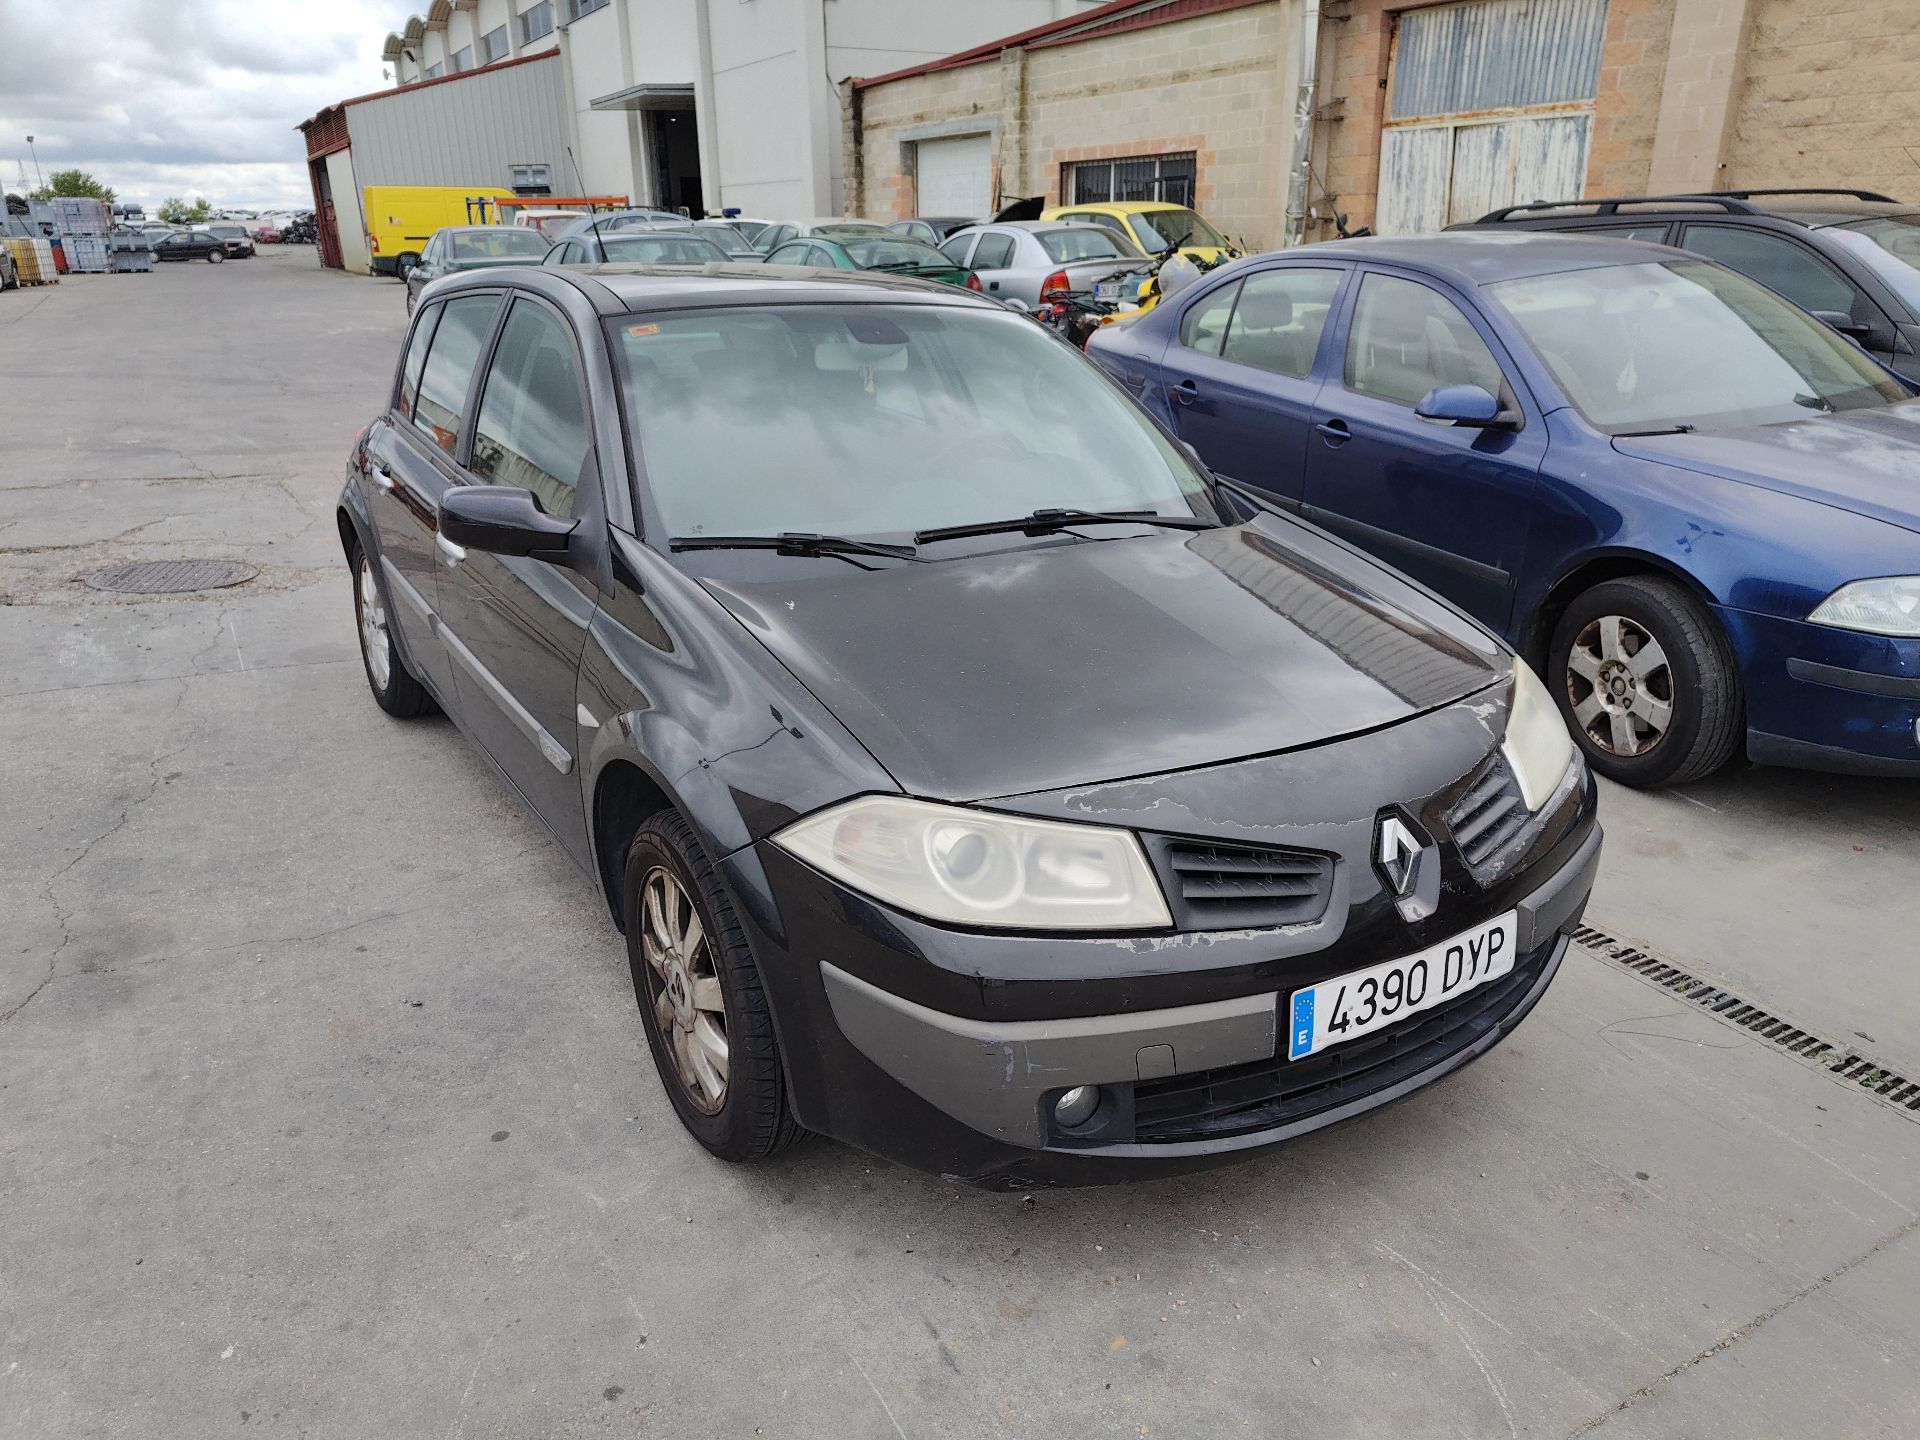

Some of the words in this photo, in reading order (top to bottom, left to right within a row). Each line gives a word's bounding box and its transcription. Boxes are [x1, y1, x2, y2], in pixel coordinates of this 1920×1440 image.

[1328, 960, 1428, 1034] 4390
[1442, 926, 1505, 994] DYP
[1298, 1029, 1308, 1046] E
